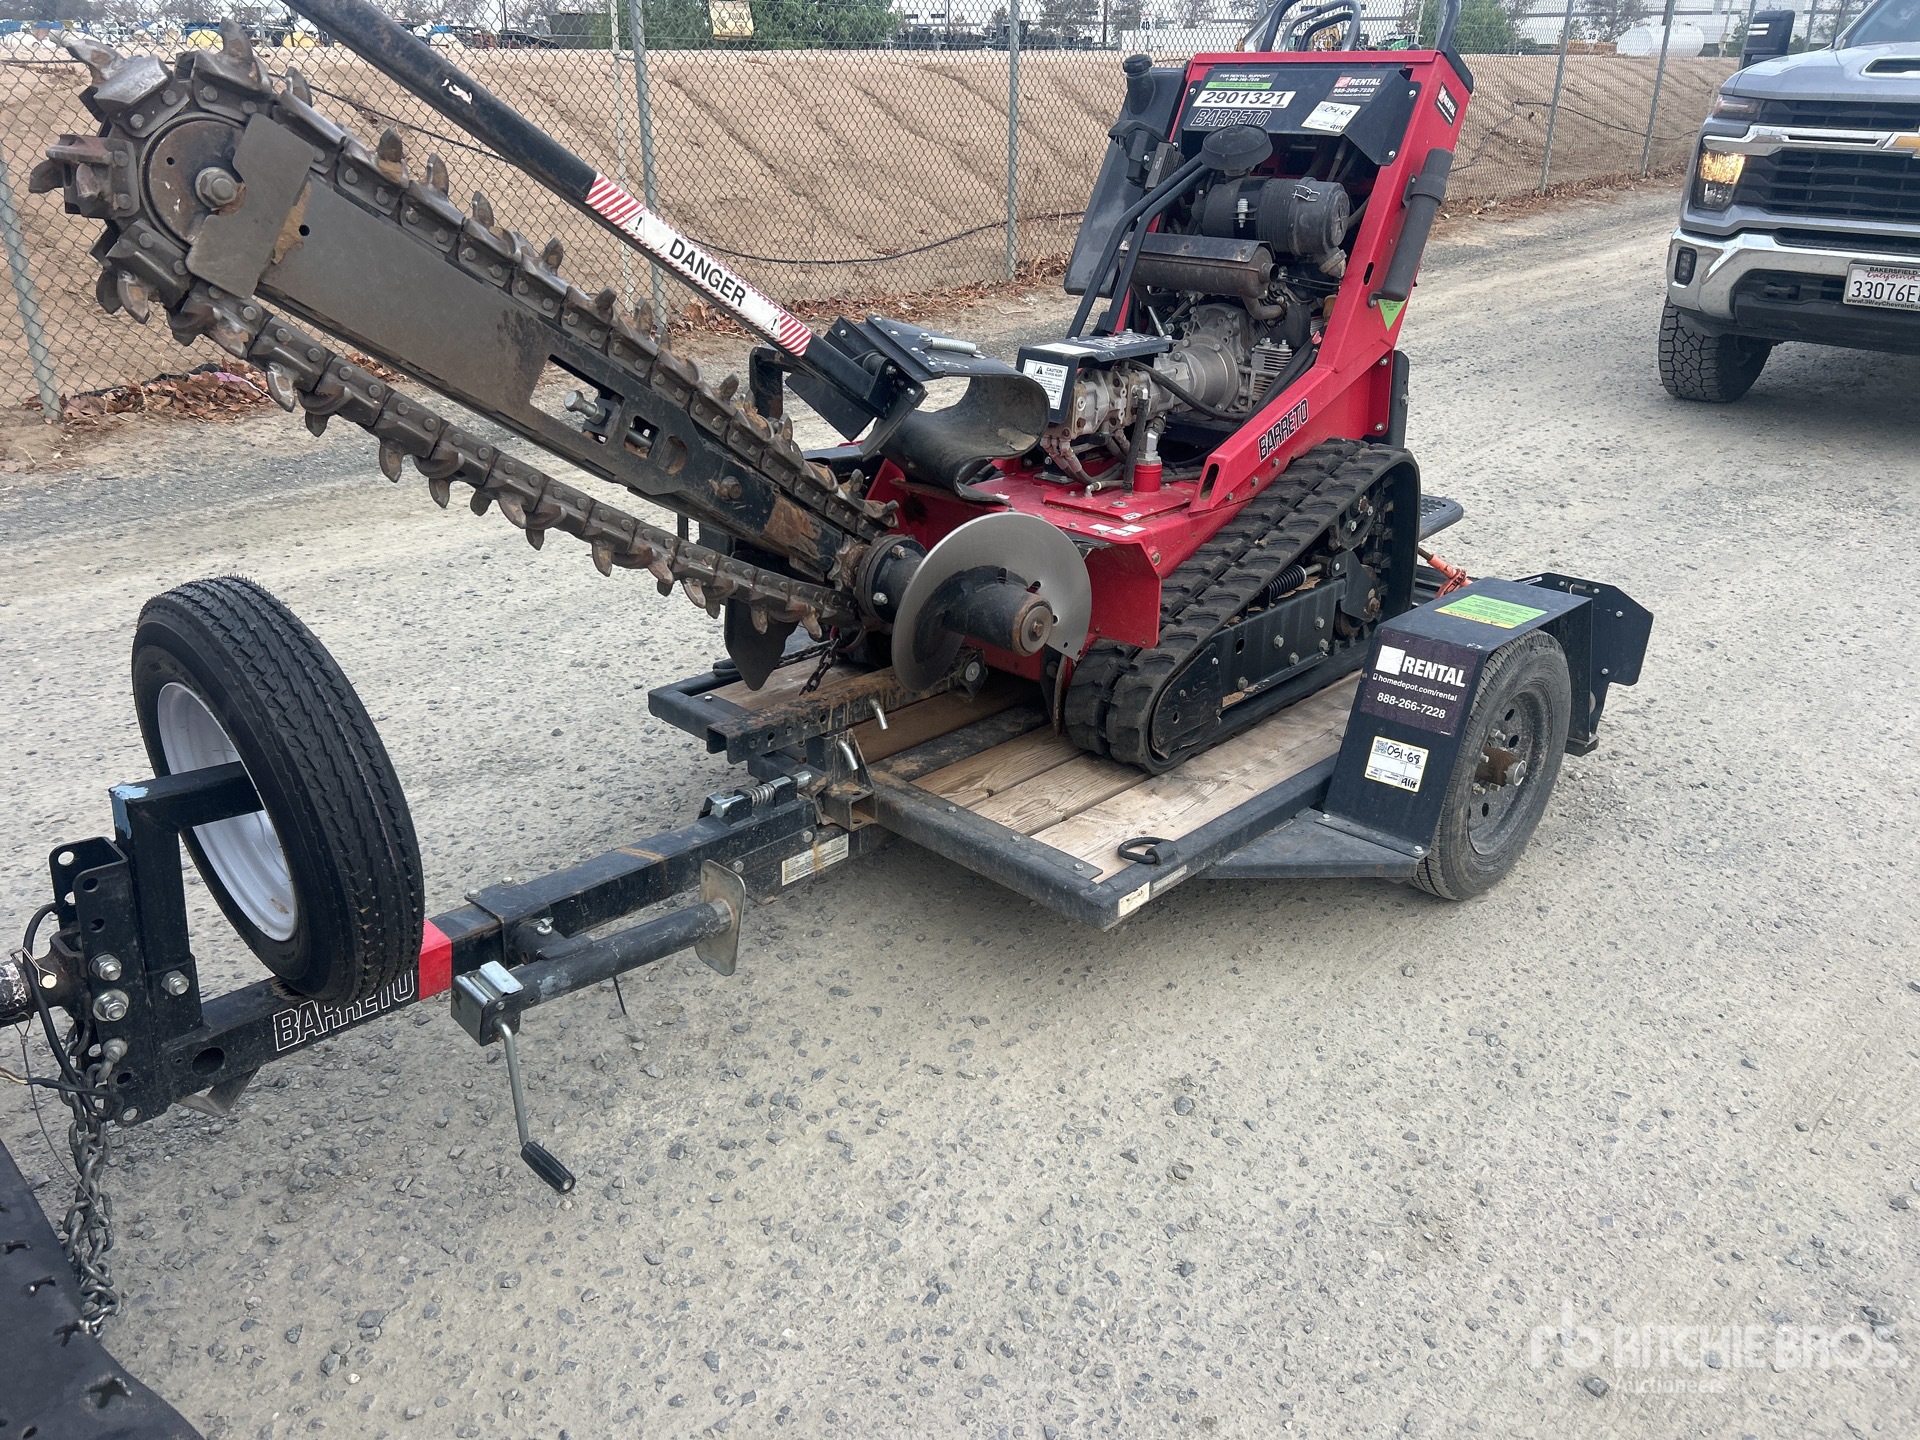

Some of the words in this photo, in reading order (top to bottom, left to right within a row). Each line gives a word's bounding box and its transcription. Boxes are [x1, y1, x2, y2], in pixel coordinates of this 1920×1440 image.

[1348, 78, 1381, 86] RENTAL
[1201, 91, 1287, 105] 2901321
[1190, 108, 1272, 128] BARRETO
[668, 237, 747, 308] DANGER
[1851, 280, 1920, 304] 33076E
[1257, 397, 1309, 463] BARRETO
[1401, 655, 1466, 688] RENTAL
[1378, 674, 1458, 702] homedepot.com/rental
[1376, 692, 1447, 719] 888-266-7228
